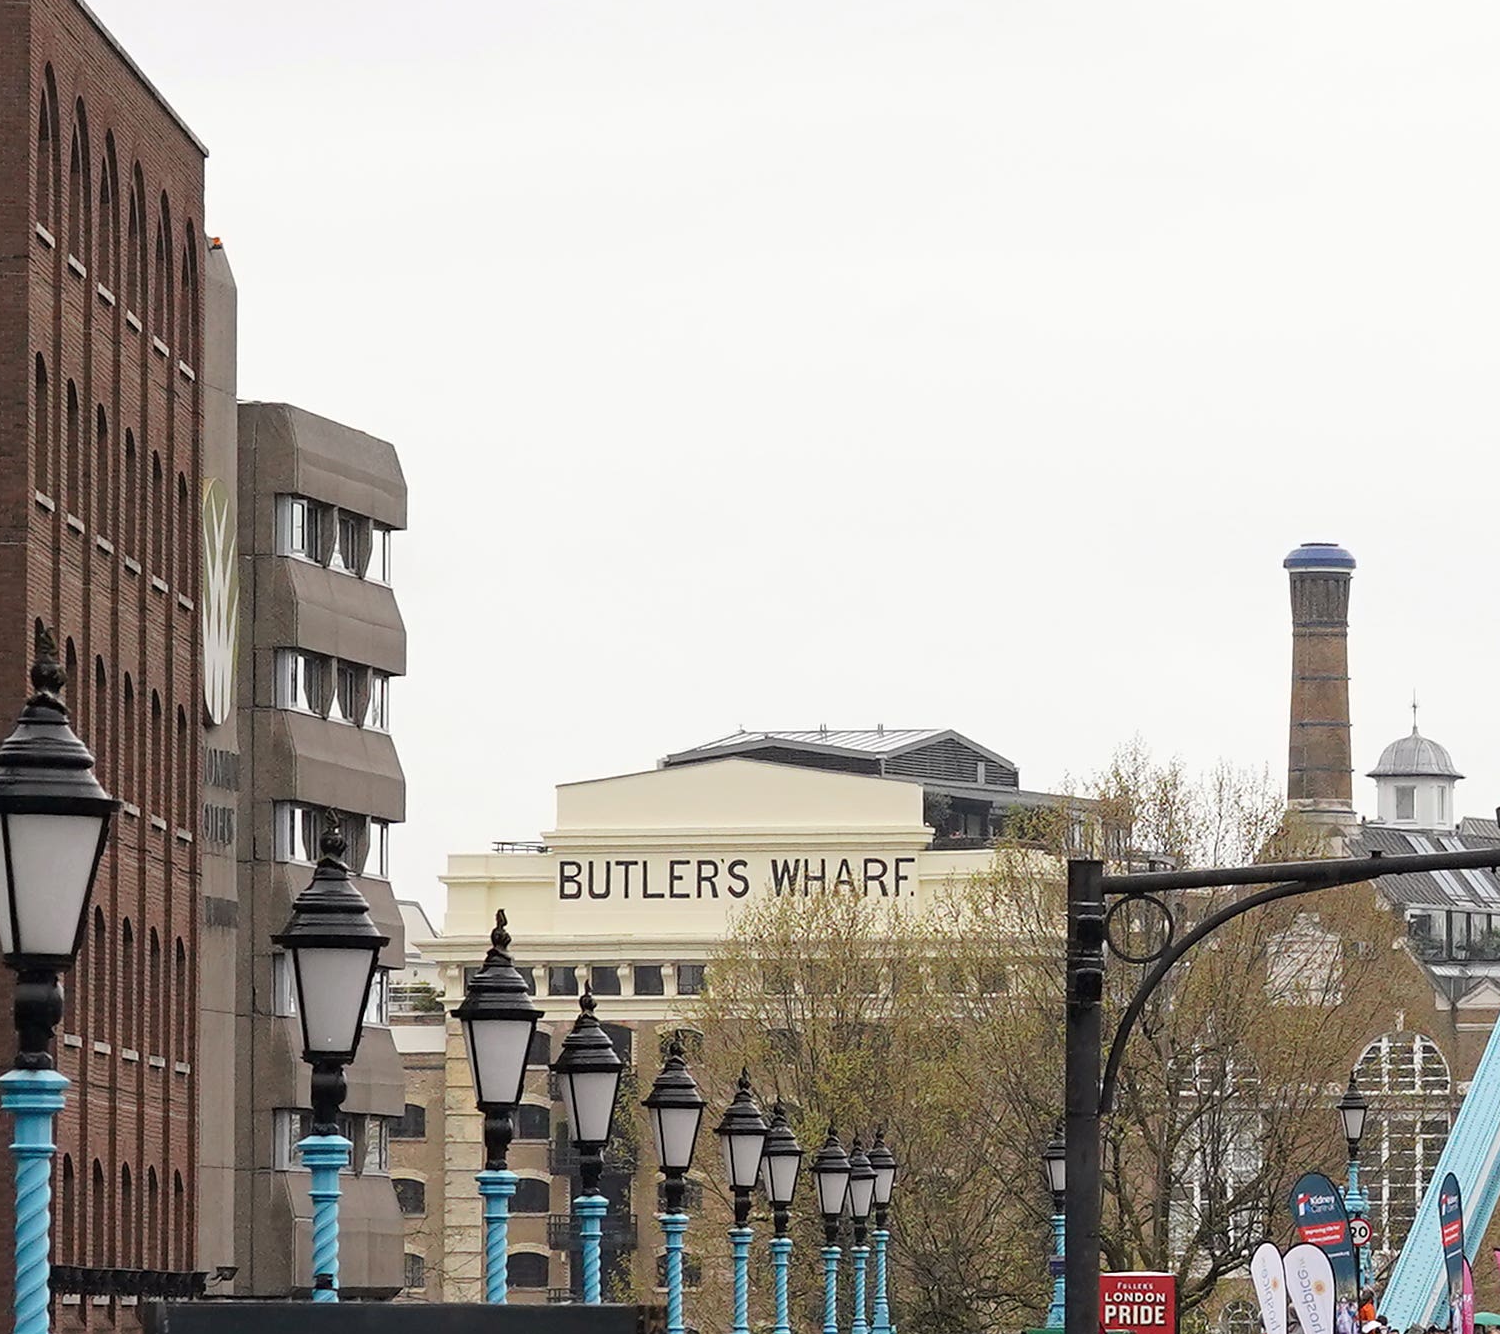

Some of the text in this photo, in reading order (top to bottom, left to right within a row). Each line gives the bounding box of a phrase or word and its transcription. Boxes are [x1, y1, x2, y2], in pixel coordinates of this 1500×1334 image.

[558, 859, 750, 900] BUTLER'S
[1351, 1227, 1368, 1238] 20
[1104, 1292, 1166, 1303] LONDON
[1104, 1305, 1166, 1326] PRIDE
